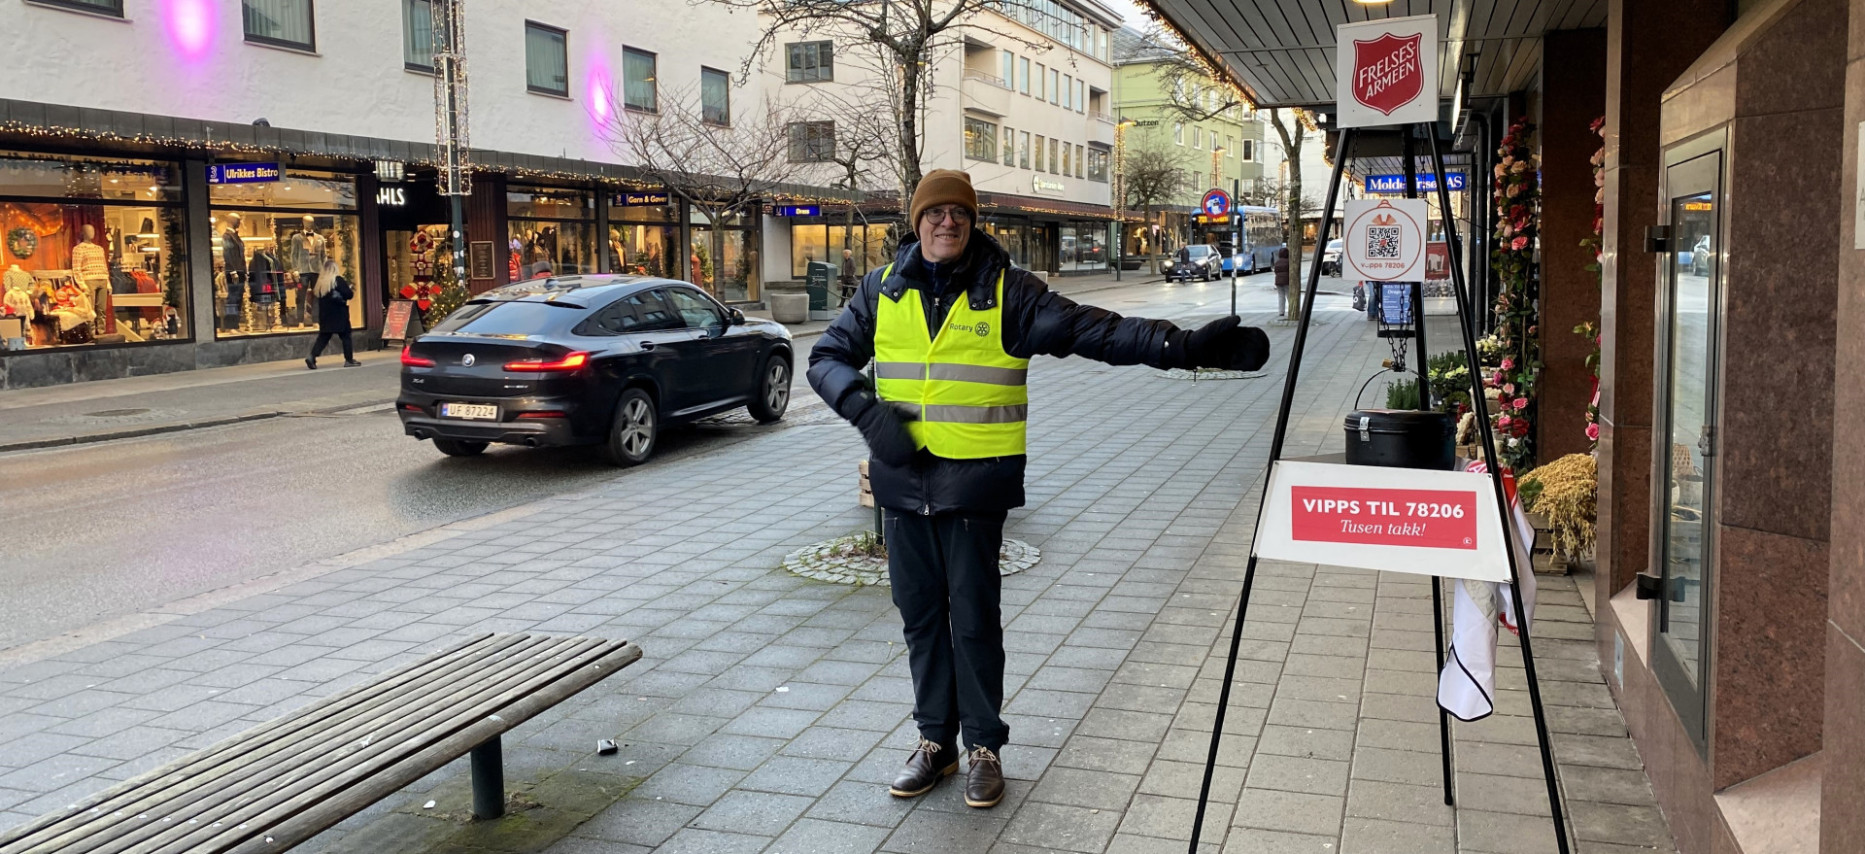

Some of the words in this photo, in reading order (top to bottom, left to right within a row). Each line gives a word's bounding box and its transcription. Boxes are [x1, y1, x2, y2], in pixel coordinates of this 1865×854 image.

[1365, 58, 1414, 100] ARMEEN
[226, 168, 255, 179] Ulrikkes
[256, 167, 279, 178] Bistro
[1447, 176, 1463, 188] AS
[644, 195, 649, 203] &
[950, 323, 973, 332] Rotary
[449, 405, 462, 416] UF
[466, 406, 495, 417] 87224
[1302, 498, 1360, 515] VIPPS
[1366, 500, 1400, 516] TIL
[1405, 502, 1464, 519] 78206
[1340, 519, 1383, 535] Tusen
[1387, 522, 1427, 537] takk!
